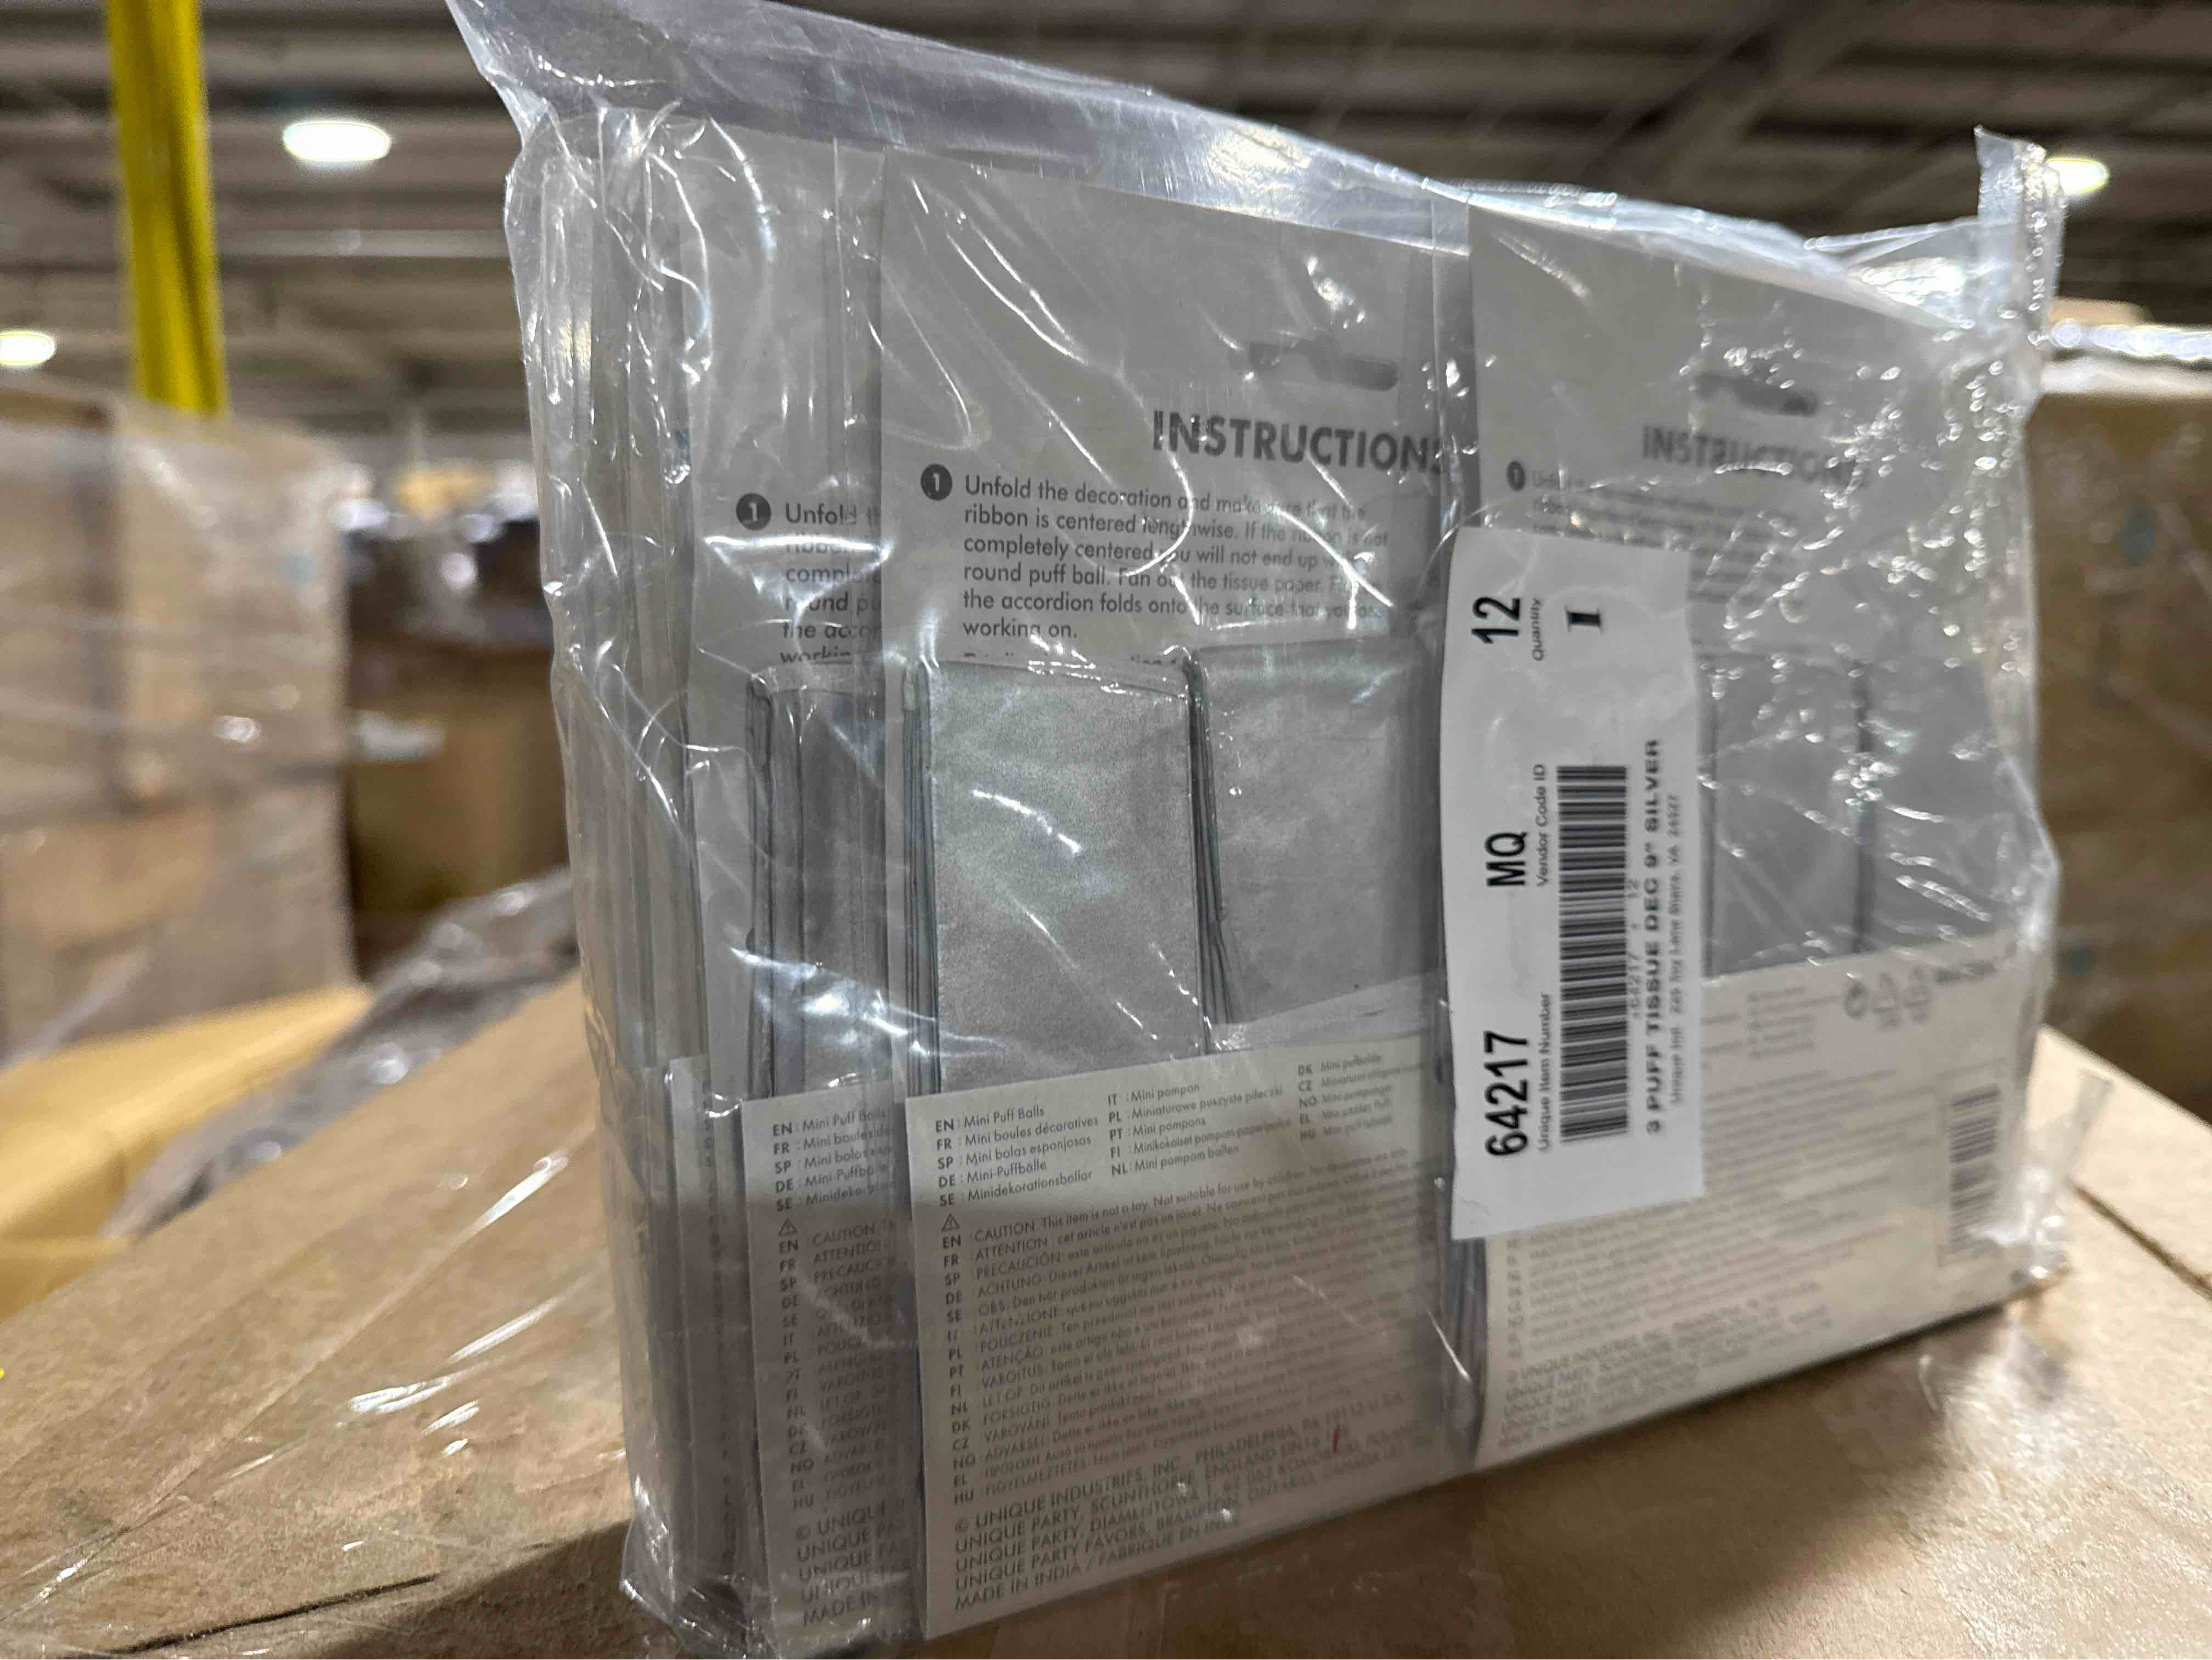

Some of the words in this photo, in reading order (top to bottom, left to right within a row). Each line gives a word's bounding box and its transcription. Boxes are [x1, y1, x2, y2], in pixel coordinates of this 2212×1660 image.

[965, 474, 1031, 499] Unfold
[1039, 479, 1068, 502] the
[1075, 482, 1171, 508] decoration
[785, 502, 857, 526] Unfold
[964, 503, 1028, 527] ribbon
[1036, 508, 1049, 528] is
[1056, 513, 1136, 533] centered
[1245, 521, 1256, 538] If
[964, 533, 1069, 560] completely
[1196, 545, 1224, 564] will
[1231, 548, 1257, 564] not
[1262, 549, 1292, 566] end
[1299, 554, 1318, 572] up
[964, 562, 1022, 582] round
[1029, 563, 1066, 588] puff
[1072, 564, 1110, 585] ball.
[1119, 567, 1150, 587] Fan
[1190, 570, 1216, 589] the
[1222, 573, 1268, 591] tissue
[963, 588, 994, 609] the
[1001, 590, 1093, 612] accordion
[1099, 593, 1142, 614] folds
[1148, 597, 1187, 614] onto
[962, 616, 1041, 638] working
[1048, 627, 1077, 638] on.
[1471, 597, 1521, 644] 12
[1531, 598, 1544, 662] Quantity
[1534, 763, 1546, 781] ID
[1645, 739, 1660, 833] SILVER
[1534, 786, 1549, 825] Code
[1485, 830, 1528, 887] MQ
[1535, 830, 1549, 888] Vendor
[1644, 877, 1660, 931] DEC
[1645, 941, 1661, 1033] TISSUE
[1539, 992, 1552, 1061] Number
[1297, 1063, 1313, 1076] DK
[1538, 1064, 1550, 1097] Item
[1646, 1047, 1661, 1115] PUFF
[1108, 1093, 1118, 1107] IT
[1131, 1088, 1155, 1102] Mini
[1158, 1083, 1200, 1101] pompon
[1298, 1079, 1313, 1093] CZ
[1484, 1029, 1528, 1157] 64217
[1109, 1111, 1122, 1124] PL
[1131, 1101, 1197, 1121] Miniaturowe
[1299, 1095, 1317, 1108] NO
[772, 1122, 793, 1137] EN
[802, 1116, 830, 1132] Mini
[833, 1110, 855, 1126] Puff
[935, 1118, 955, 1133] EN
[964, 1114, 990, 1129] Mini
[993, 1107, 1015, 1123] Puff
[1018, 1103, 1045, 1120] Balls
[1109, 1128, 1123, 1141] PT
[1132, 1122, 1156, 1138] Mini
[1158, 1117, 1206, 1135] pompons
[1537, 1101, 1550, 1152] Unique
[773, 1141, 790, 1155] FR
[803, 1135, 831, 1151] Mini
[936, 1138, 952, 1151] FR
[965, 1133, 991, 1147] Mini
[994, 1126, 1032, 1143] boules
[1035, 1116, 1099, 1134] décoratives
[775, 1160, 791, 1174] SP
[804, 1153, 832, 1169] Mini
[937, 1156, 954, 1171] SP
[966, 1151, 992, 1166] Mini
[995, 1144, 1027, 1161] bolas
[1029, 1135, 1092, 1155] esponjosas
[1110, 1145, 1121, 1159] FI
[1111, 1163, 1128, 1177] NL
[1135, 1157, 1158, 1172] Mini
[1160, 1151, 1206, 1170] pompom
[775, 1178, 794, 1194] DE
[939, 1173, 956, 1189] DE
[776, 1197, 793, 1212] SE
[939, 1192, 956, 1207] SE
[1042, 1216, 1064, 1230] This
[1066, 1212, 1088, 1226] item
[1102, 1206, 1120, 1219] not
[1154, 1192, 1172, 1207] Not
[1176, 1183, 1216, 1204] suitable
[1217, 1182, 1231, 1195] for
[778, 1239, 799, 1256] EN
[942, 1235, 962, 1250] EN
[943, 1253, 960, 1269] FR
[974, 1233, 1048, 1262] ATTENTION
[1058, 1230, 1074, 1246] cet
[1077, 1222, 1111, 1241] article
[1139, 1215, 1159, 1231] pas
[944, 1271, 961, 1287] SP
[945, 1290, 963, 1306] DE
[946, 1308, 962, 1324] SE
[949, 1363, 964, 1380] PT
[950, 1382, 961, 1398] FI
[951, 1419, 971, 1435] DK
[952, 1436, 970, 1451] CZ
[953, 1452, 976, 1470] NO
[953, 1487, 974, 1506] HU
[975, 1492, 1045, 1529] UNIQUE
[955, 1520, 1025, 1554] UNIQUE
[955, 1539, 1025, 1573] UNIQUE
[955, 1558, 1025, 1591] UNIQUE
[1031, 1542, 1079, 1570] PARTY
[954, 1582, 1005, 1613] MADE
[1010, 1575, 1028, 1594] IN
[1035, 1561, 1081, 1587] INDIA
